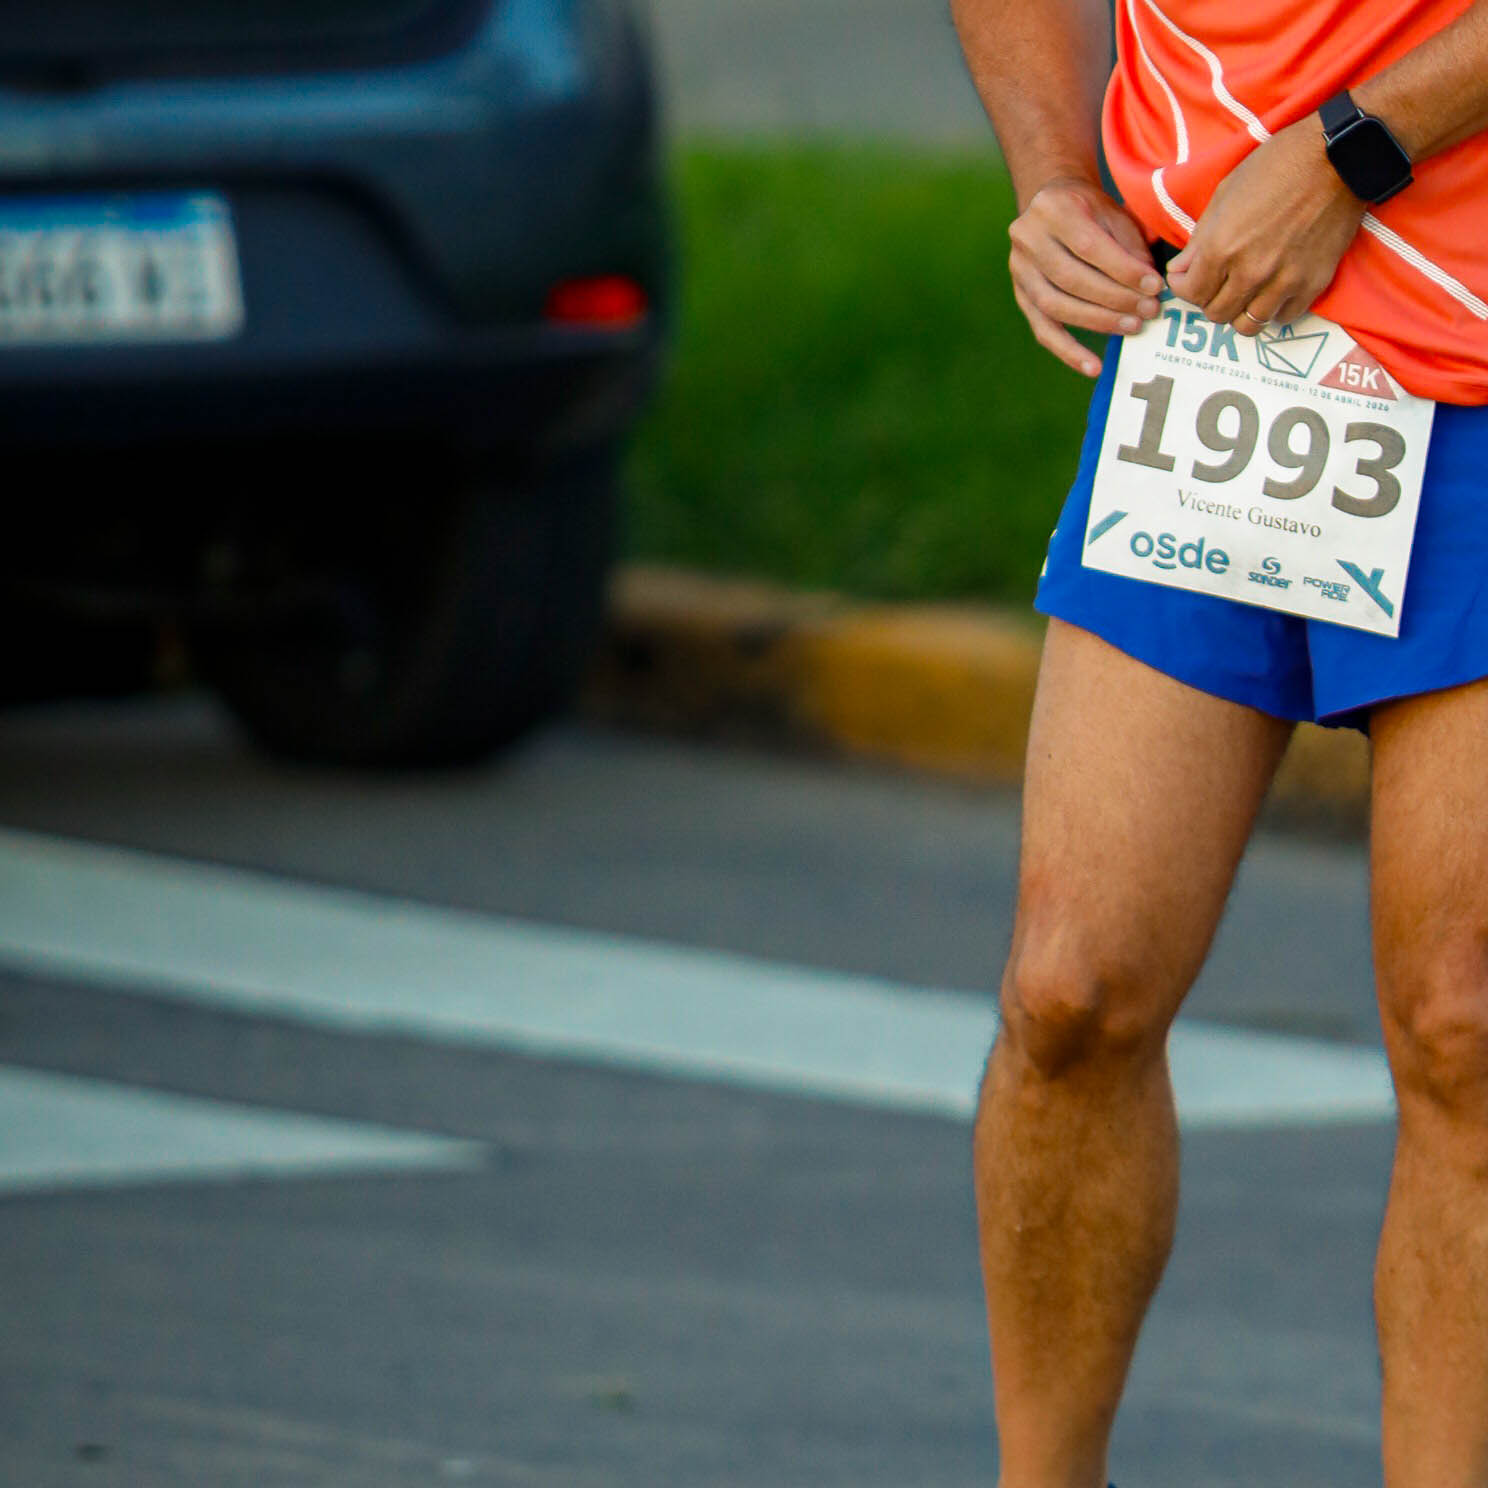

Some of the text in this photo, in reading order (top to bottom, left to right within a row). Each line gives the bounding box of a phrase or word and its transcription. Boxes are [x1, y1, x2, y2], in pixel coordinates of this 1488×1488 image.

[1163, 308, 1240, 362] 15K
[1154, 352, 1192, 367] PUERTO
[1195, 361, 1226, 374] NORTE
[1321, 391, 1332, 400] DE
[1335, 394, 1362, 407] ABRIL
[1338, 361, 1380, 391] 15K
[1117, 374, 1407, 519] 1993
[1178, 488, 1321, 537] Vicente Gustavo
[1130, 531, 1230, 574] osde
[1303, 576, 1351, 593] POWER
